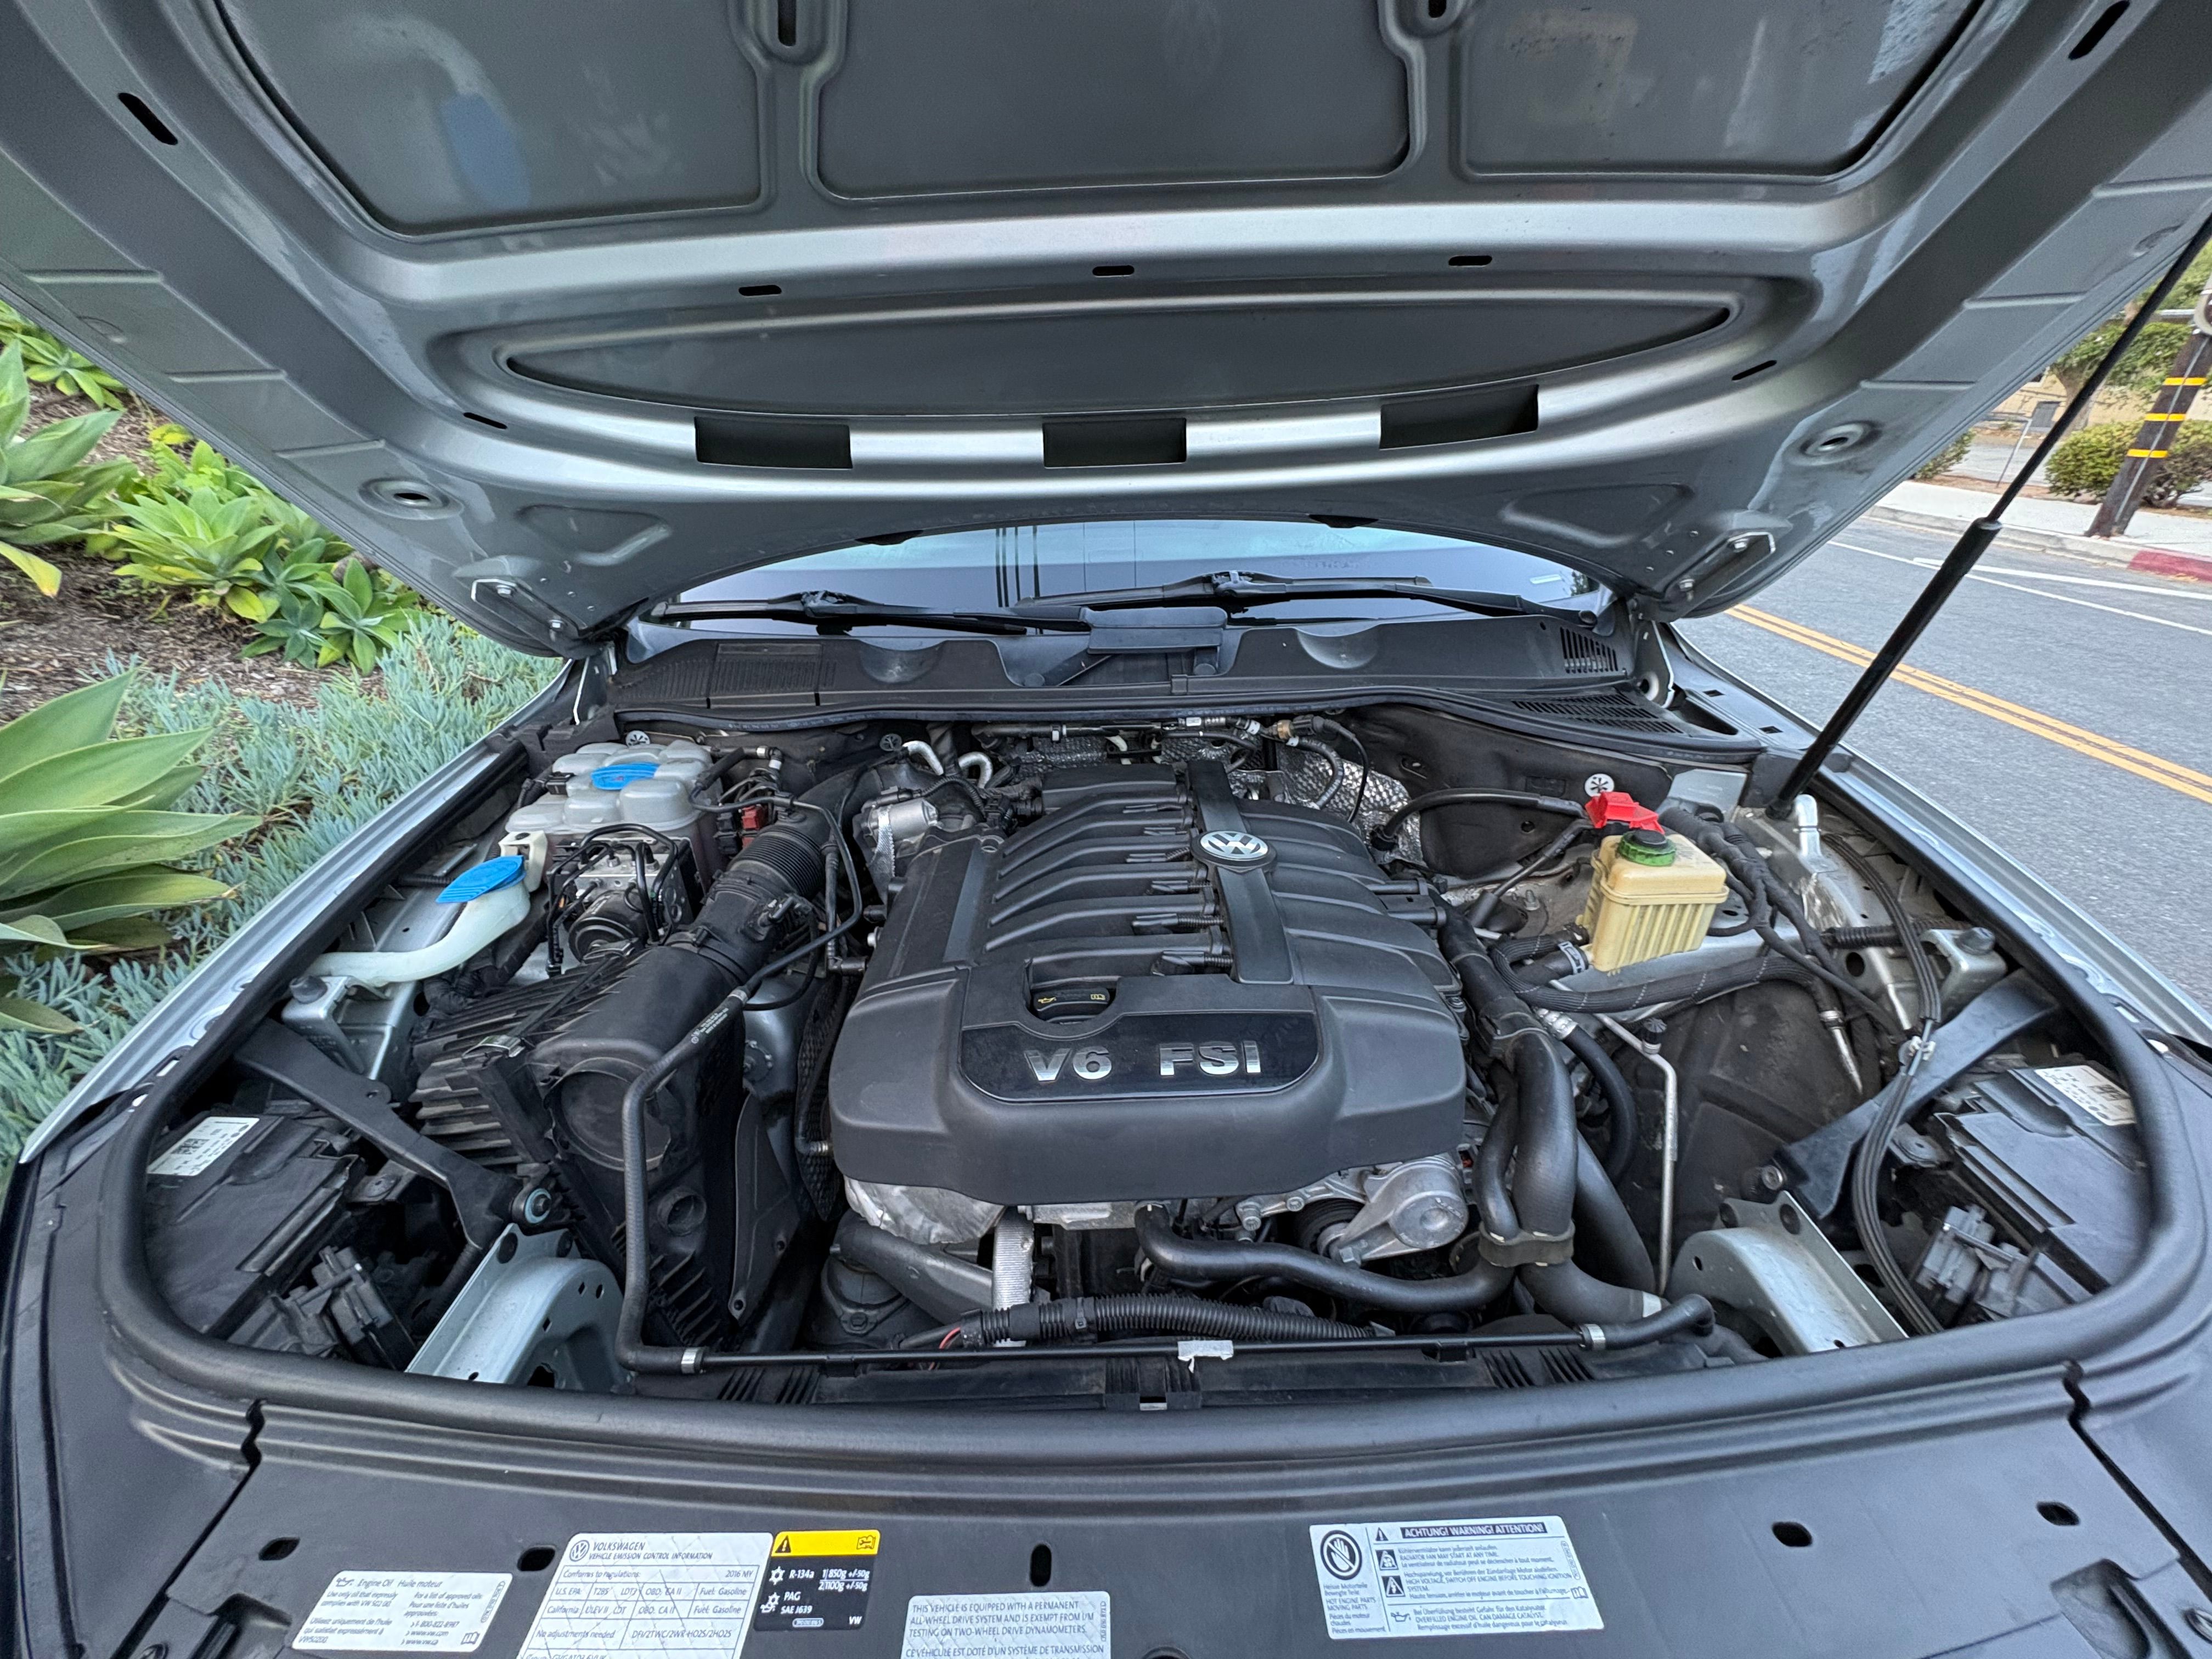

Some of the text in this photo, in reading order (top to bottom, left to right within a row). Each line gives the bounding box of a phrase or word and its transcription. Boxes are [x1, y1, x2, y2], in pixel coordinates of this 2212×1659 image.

[1024, 1041, 1261, 1081] V6 FSI
[1404, 1523, 1544, 1537] ACHTUNG! WARNING! ATTENTION!
[592, 1542, 645, 1551] VOLKSWAGEN
[563, 1568, 594, 1578] Conforms
[725, 1570, 741, 1578] 2016
[789, 1569, 815, 1579] R-134a
[828, 1568, 847, 1579] 850g
[848, 1568, 870, 1579] +/-50g
[357, 1579, 381, 1589] Engine
[382, 1579, 394, 1587] Oil
[845, 1581, 868, 1592] +/-50g
[718, 1587, 747, 1595] Gasoline
[784, 1591, 801, 1601] PAG
[713, 1606, 741, 1614] Gasoline
[780, 1605, 813, 1615] SAE J639
[913, 1601, 1079, 1613] THIS VEHICLE IS EQUIPPED WITH A PERMANENT
[849, 1616, 862, 1624] VW
[952, 1615, 974, 1624] DRIVE
[975, 1615, 1002, 1623] SYSTEM
[1004, 1614, 1020, 1622] AND
[1022, 1613, 1029, 1622] IS
[1030, 1613, 1058, 1622] EXEMPT
[1060, 1612, 1080, 1621] FROM
[547, 1629, 588, 1640] adjustments
[590, 1630, 616, 1638] needed
[909, 1628, 939, 1637] TESTING
[941, 1628, 952, 1637] ON
[955, 1627, 1000, 1637] TWO-WHEEL
[1002, 1626, 1023, 1635] DRIVE
[906, 1644, 1104, 1657] CE VÉHICULE EST DOTÉ D'UN SYSTÈME DE TRANSMISSION
